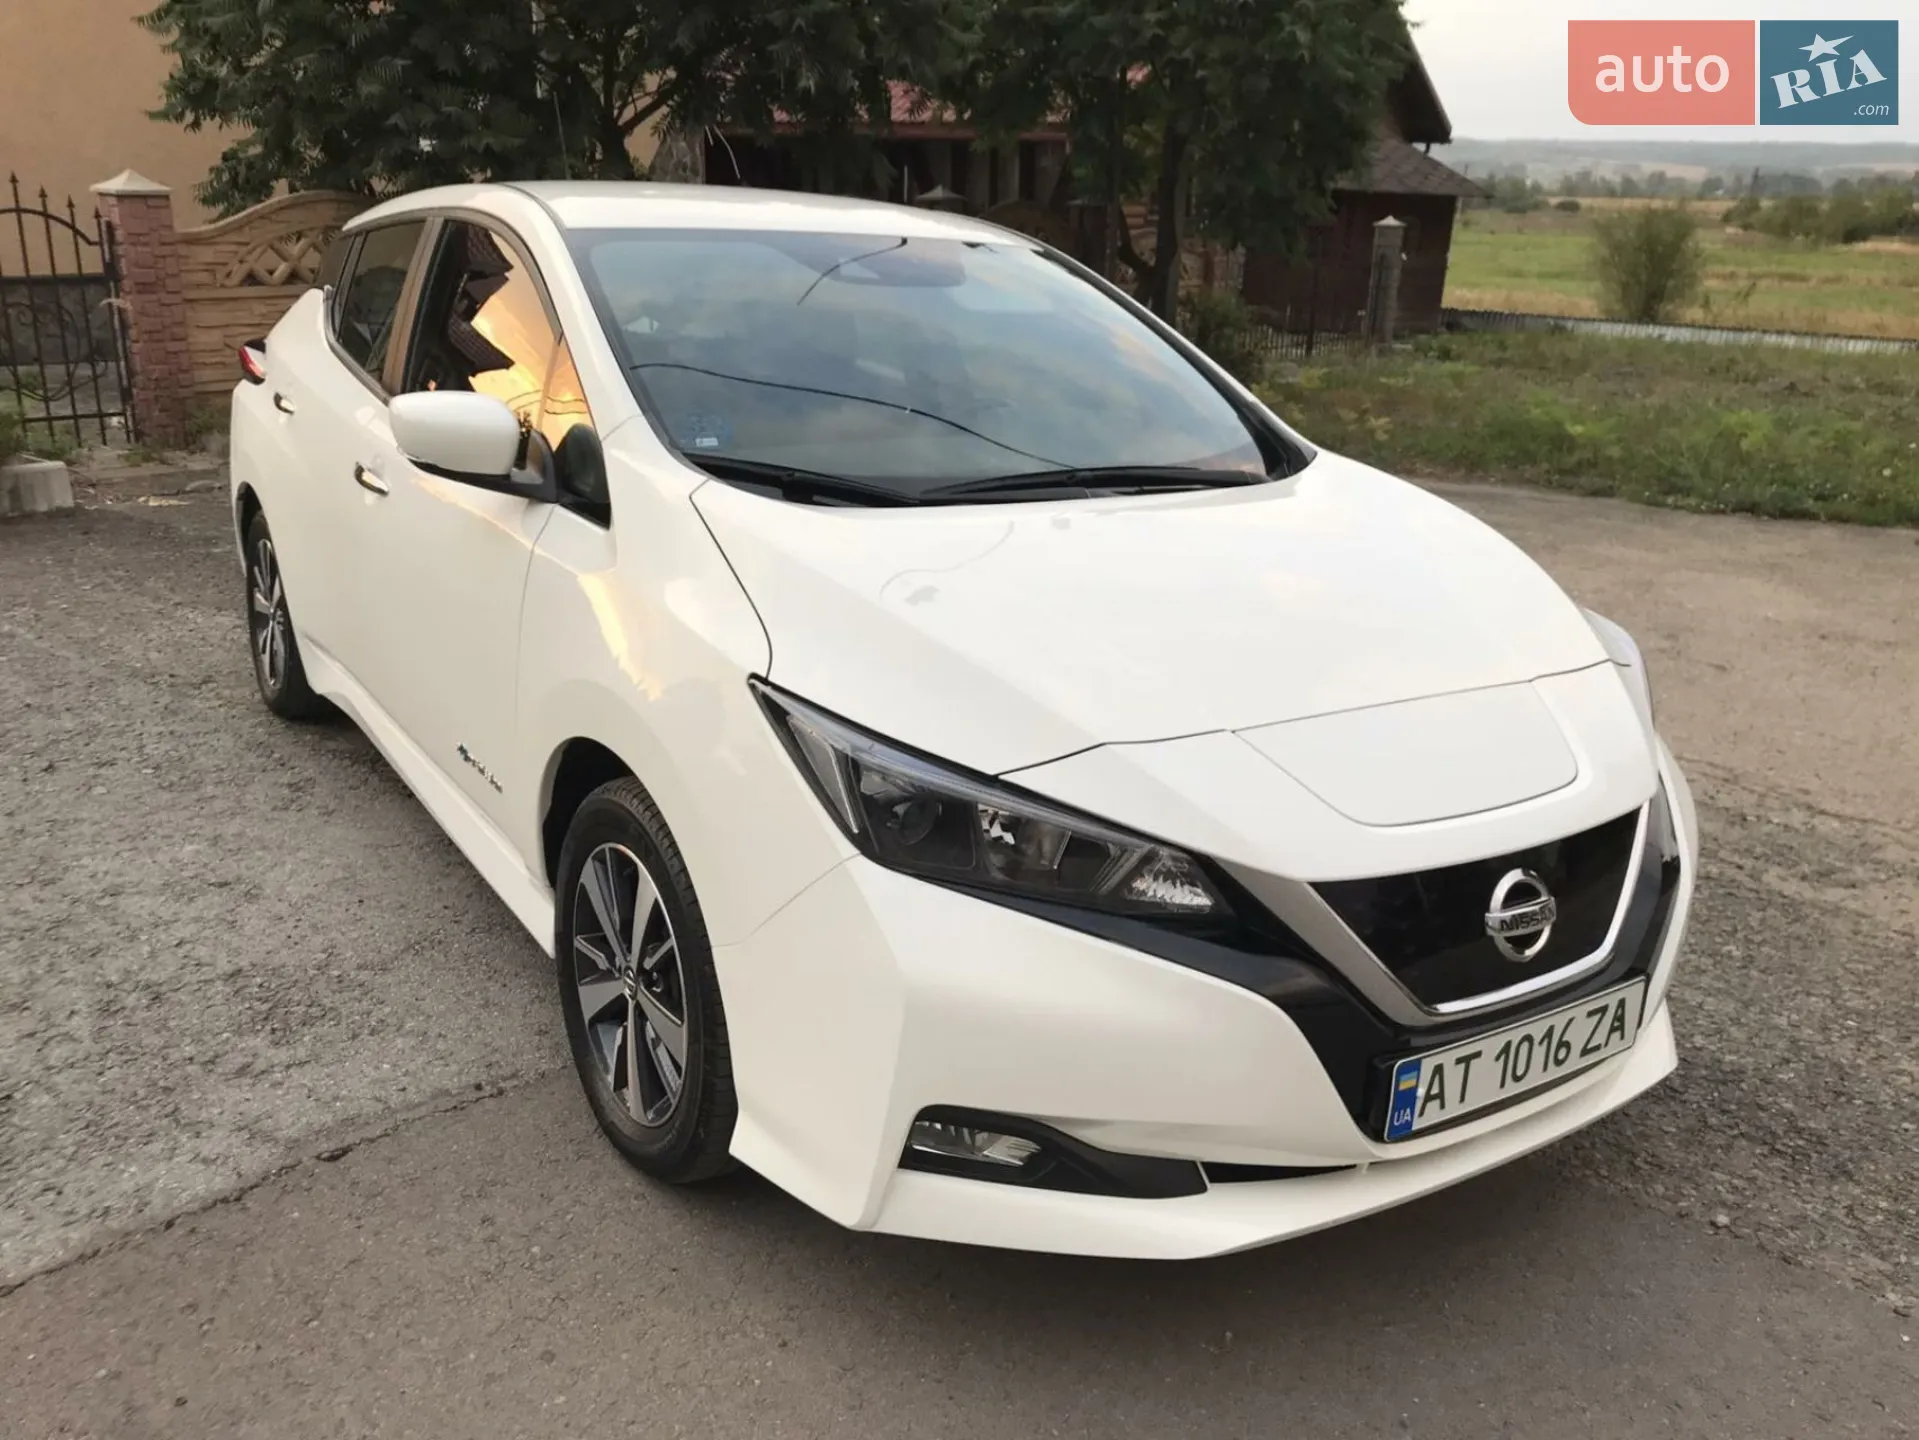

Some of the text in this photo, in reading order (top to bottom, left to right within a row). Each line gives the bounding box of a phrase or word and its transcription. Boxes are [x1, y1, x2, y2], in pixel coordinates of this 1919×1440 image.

[1500, 906, 1555, 931] NISSAN
[1418, 997, 1626, 1118] AT 1016 ZA
[1393, 1107, 1412, 1126] UA
